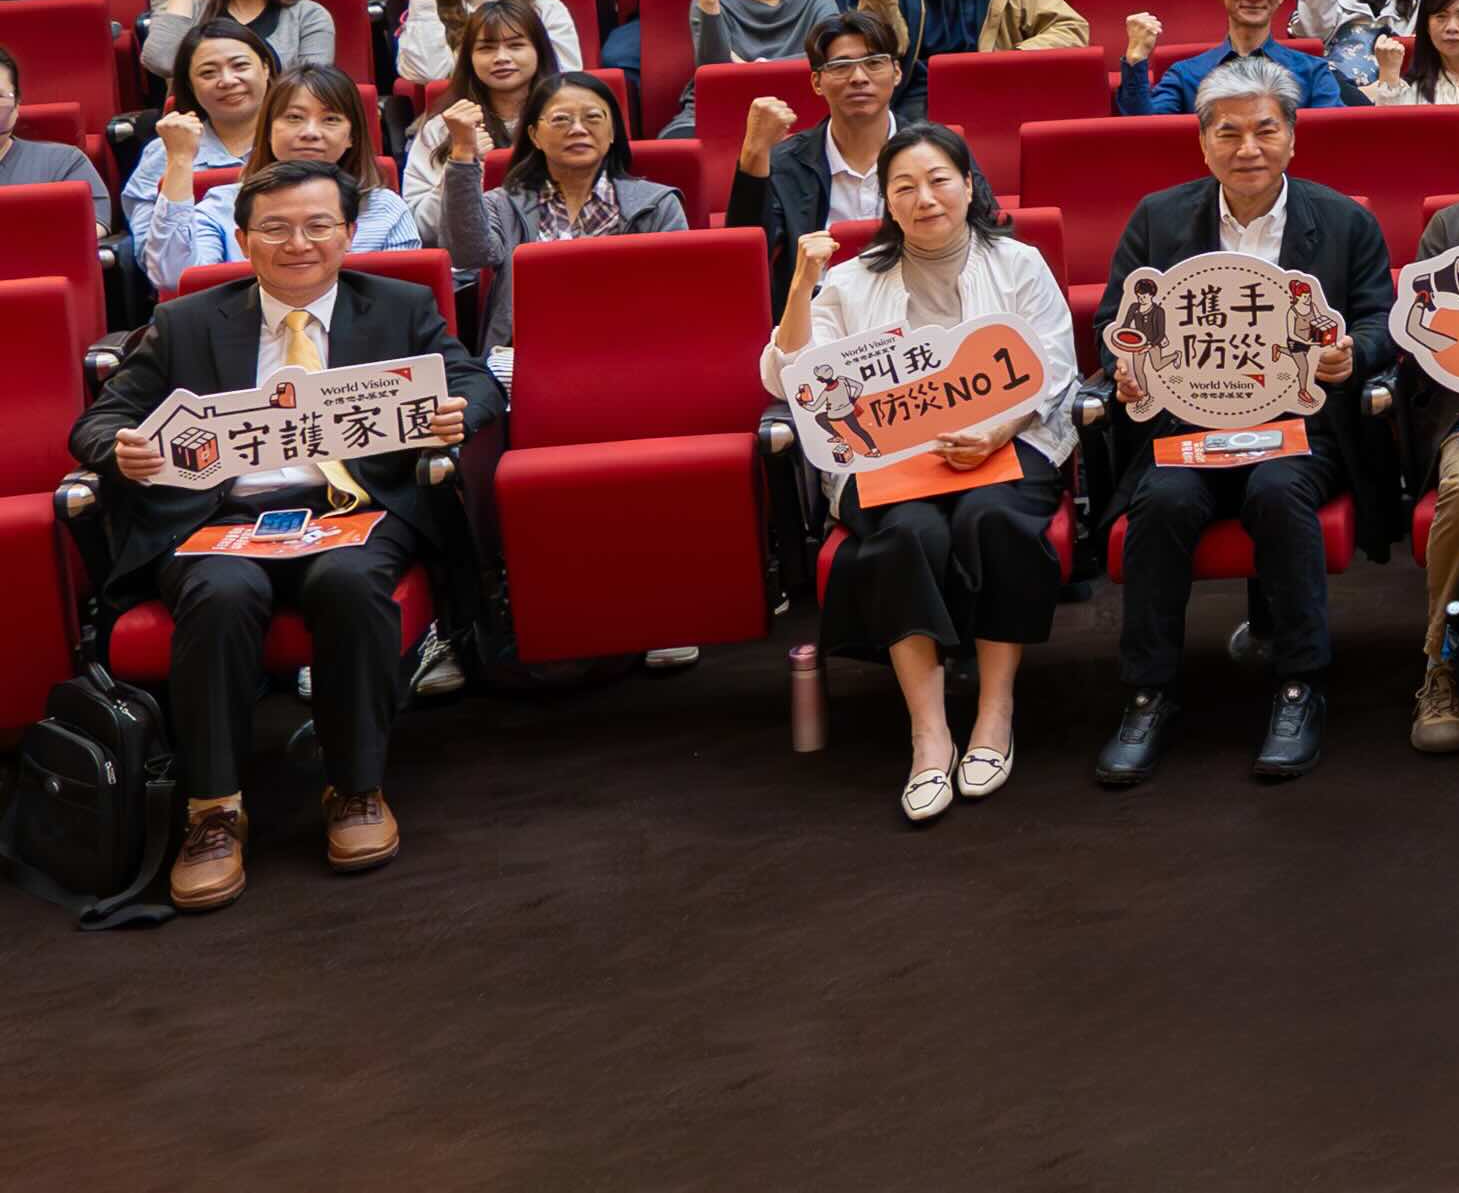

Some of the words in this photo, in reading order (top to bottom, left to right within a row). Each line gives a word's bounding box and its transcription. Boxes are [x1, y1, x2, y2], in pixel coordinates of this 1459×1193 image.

[1176, 282, 1274, 328] 攜手
[860, 343, 941, 384] 叫我
[1183, 333, 1266, 370] 防災
[320, 381, 359, 396] World
[361, 377, 400, 389] Vision
[1189, 380, 1220, 390] World
[1222, 380, 1254, 390] Vision
[229, 396, 439, 465] 守護家園
